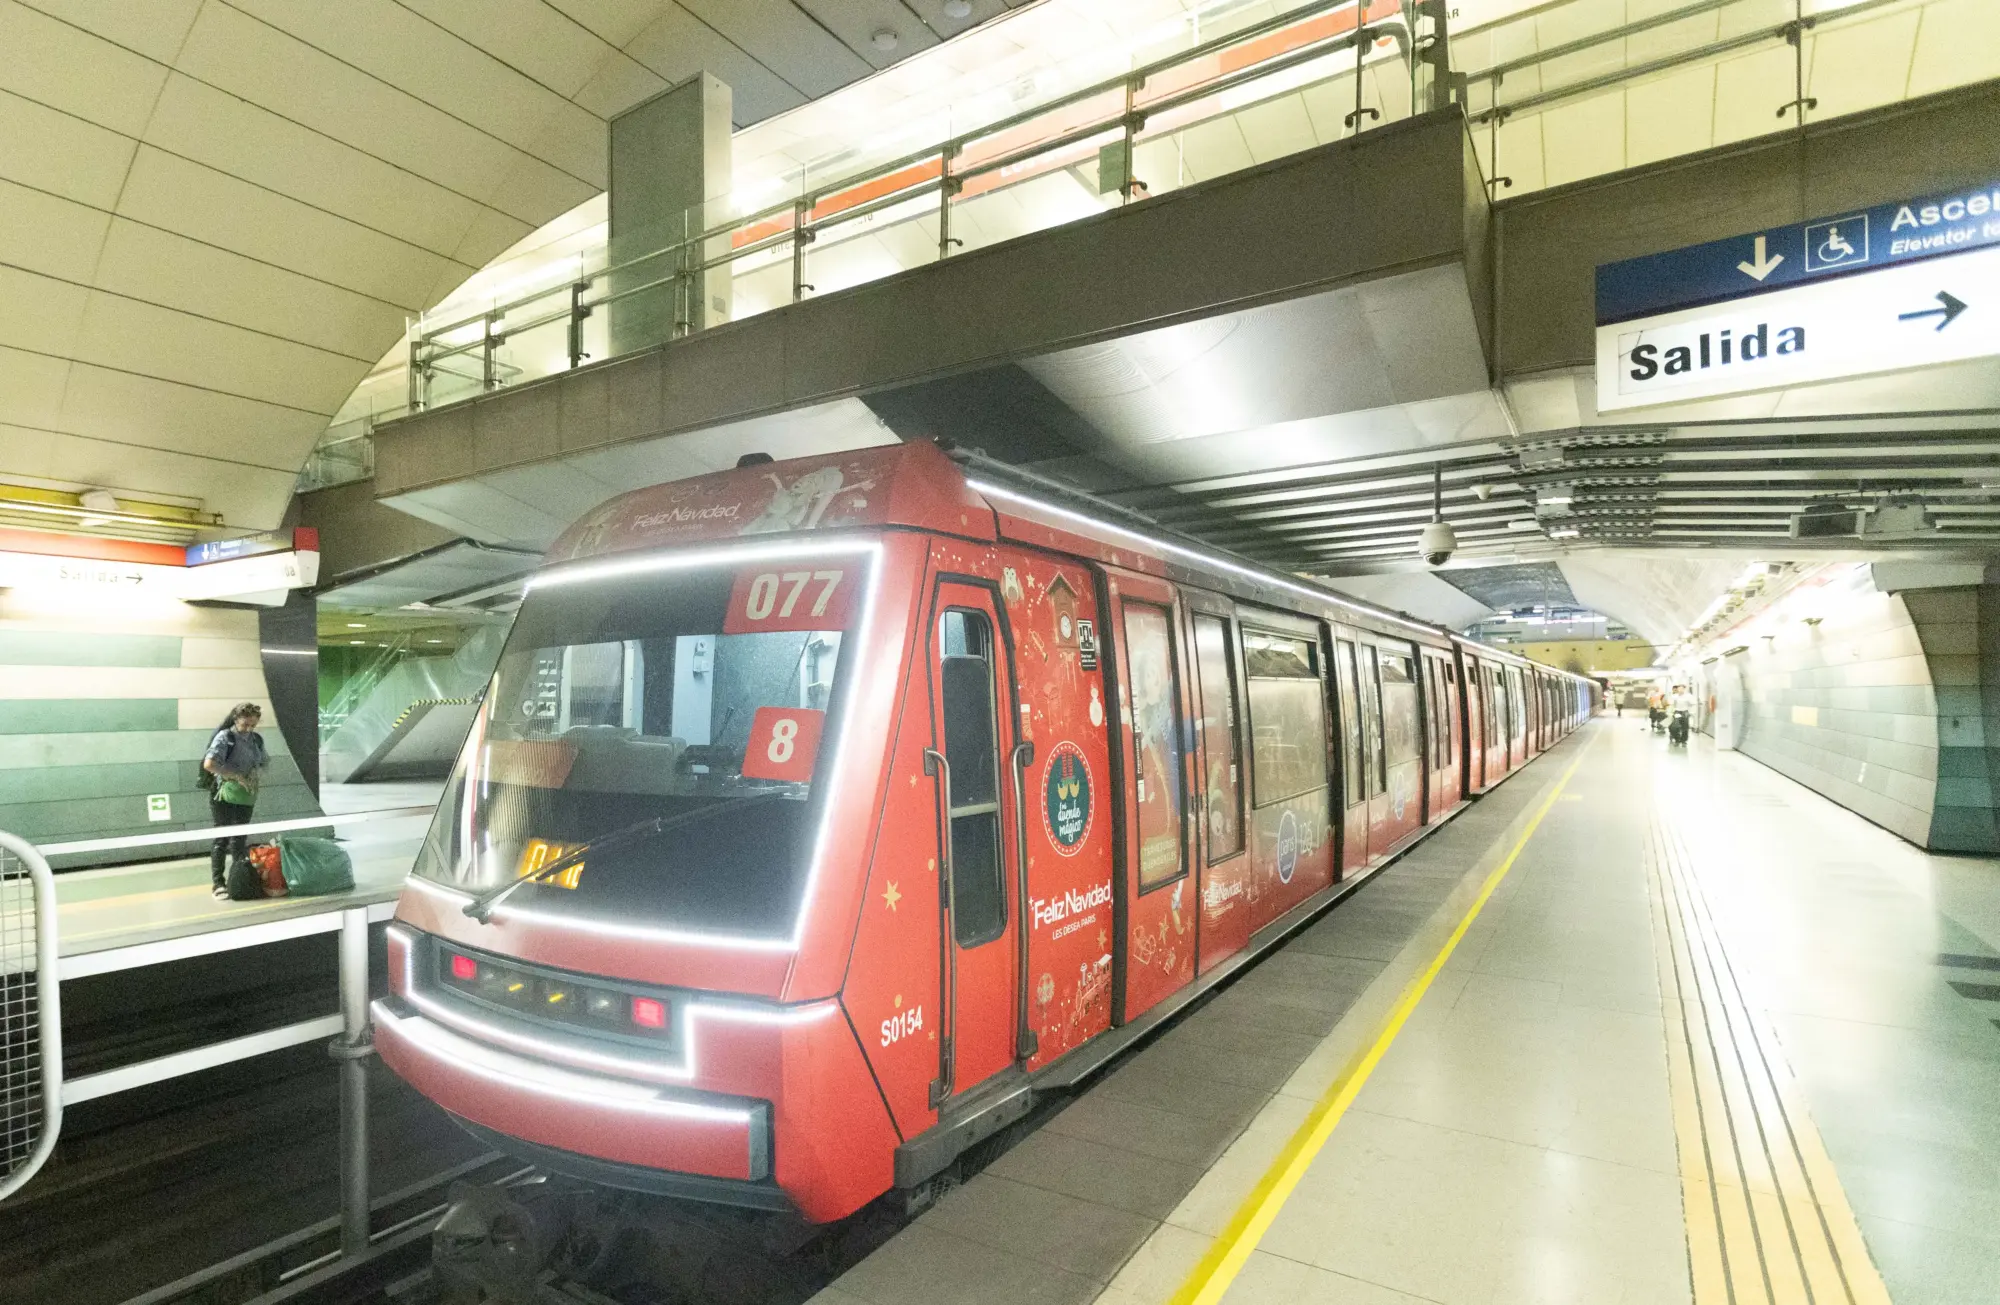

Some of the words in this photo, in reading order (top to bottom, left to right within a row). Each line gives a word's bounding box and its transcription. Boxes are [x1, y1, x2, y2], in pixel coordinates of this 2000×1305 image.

[1890, 228, 1976, 255] Elevator
[1630, 323, 1805, 381] Salida
[631, 511, 669, 531] Feliz
[667, 502, 741, 523] Navidad
[745, 570, 844, 620] 077
[767, 718, 798, 763] 8
[1057, 799, 1081, 821] duende
[1034, 898, 1065, 931] Feliz
[1065, 879, 1111, 917] Navidad
[1052, 928, 1063, 941] LES
[1062, 920, 1081, 936] DESEA
[1080, 912, 1097, 927] PARIS
[880, 1004, 923, 1048] S0154
